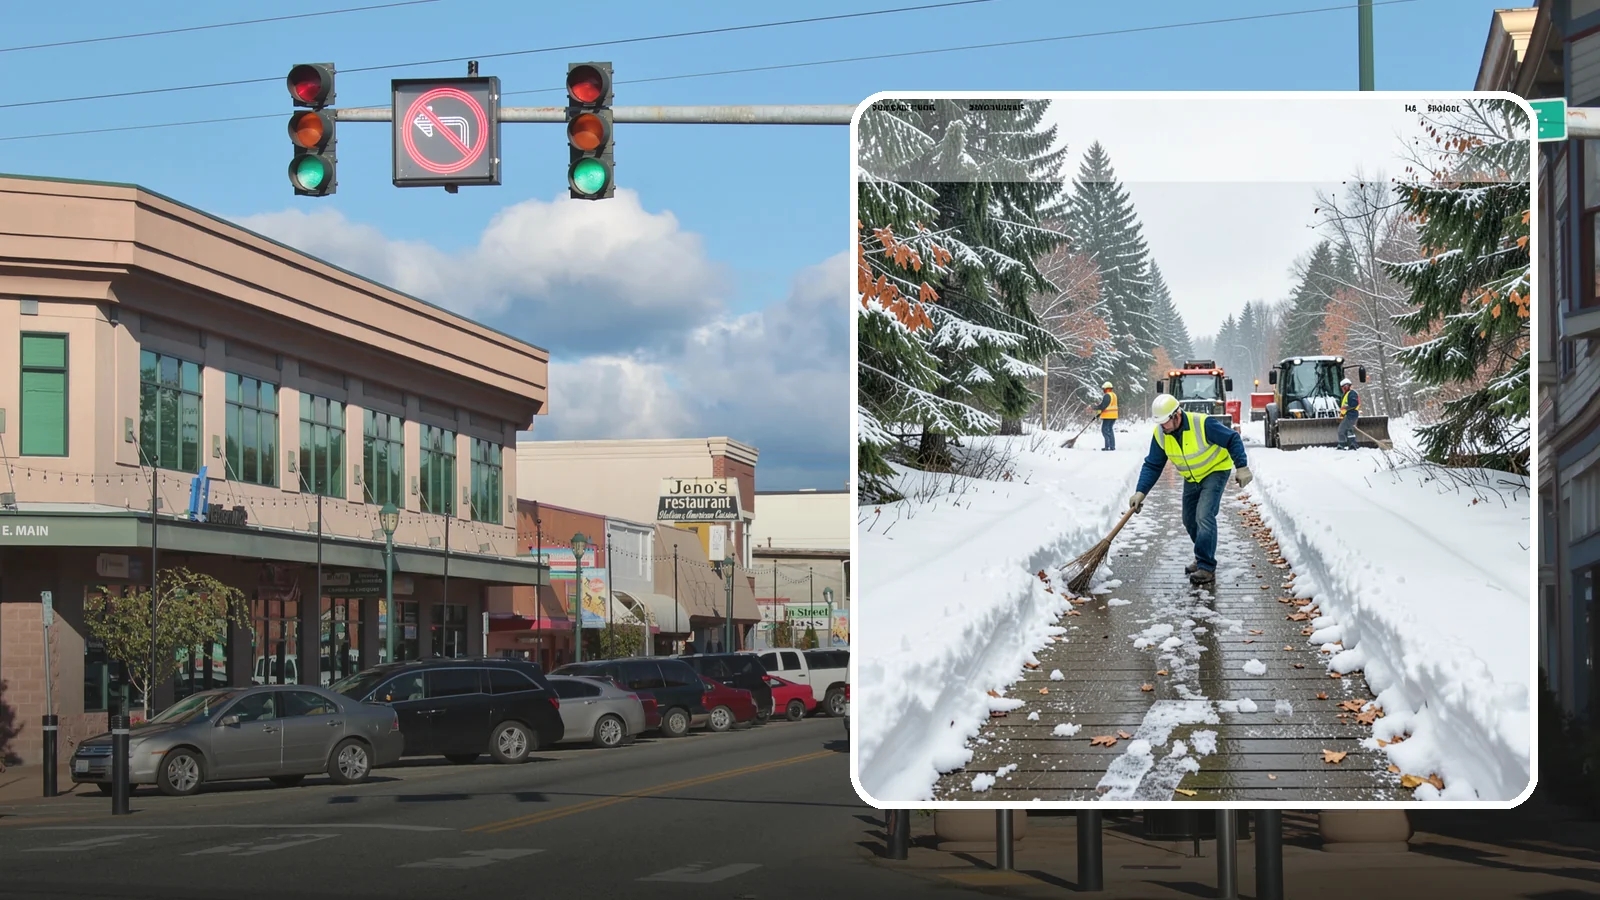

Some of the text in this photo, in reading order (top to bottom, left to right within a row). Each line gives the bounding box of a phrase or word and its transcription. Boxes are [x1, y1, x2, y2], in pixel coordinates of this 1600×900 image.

[670, 480, 727, 494] Jeno's
[665, 496, 731, 509] restaurant
[658, 509, 682, 519] Italian
[686, 509, 715, 519] American
[715, 509, 738, 519] Cuisine
[2, 525, 49, 536] E. MAIN
[797, 607, 828, 617] Street
